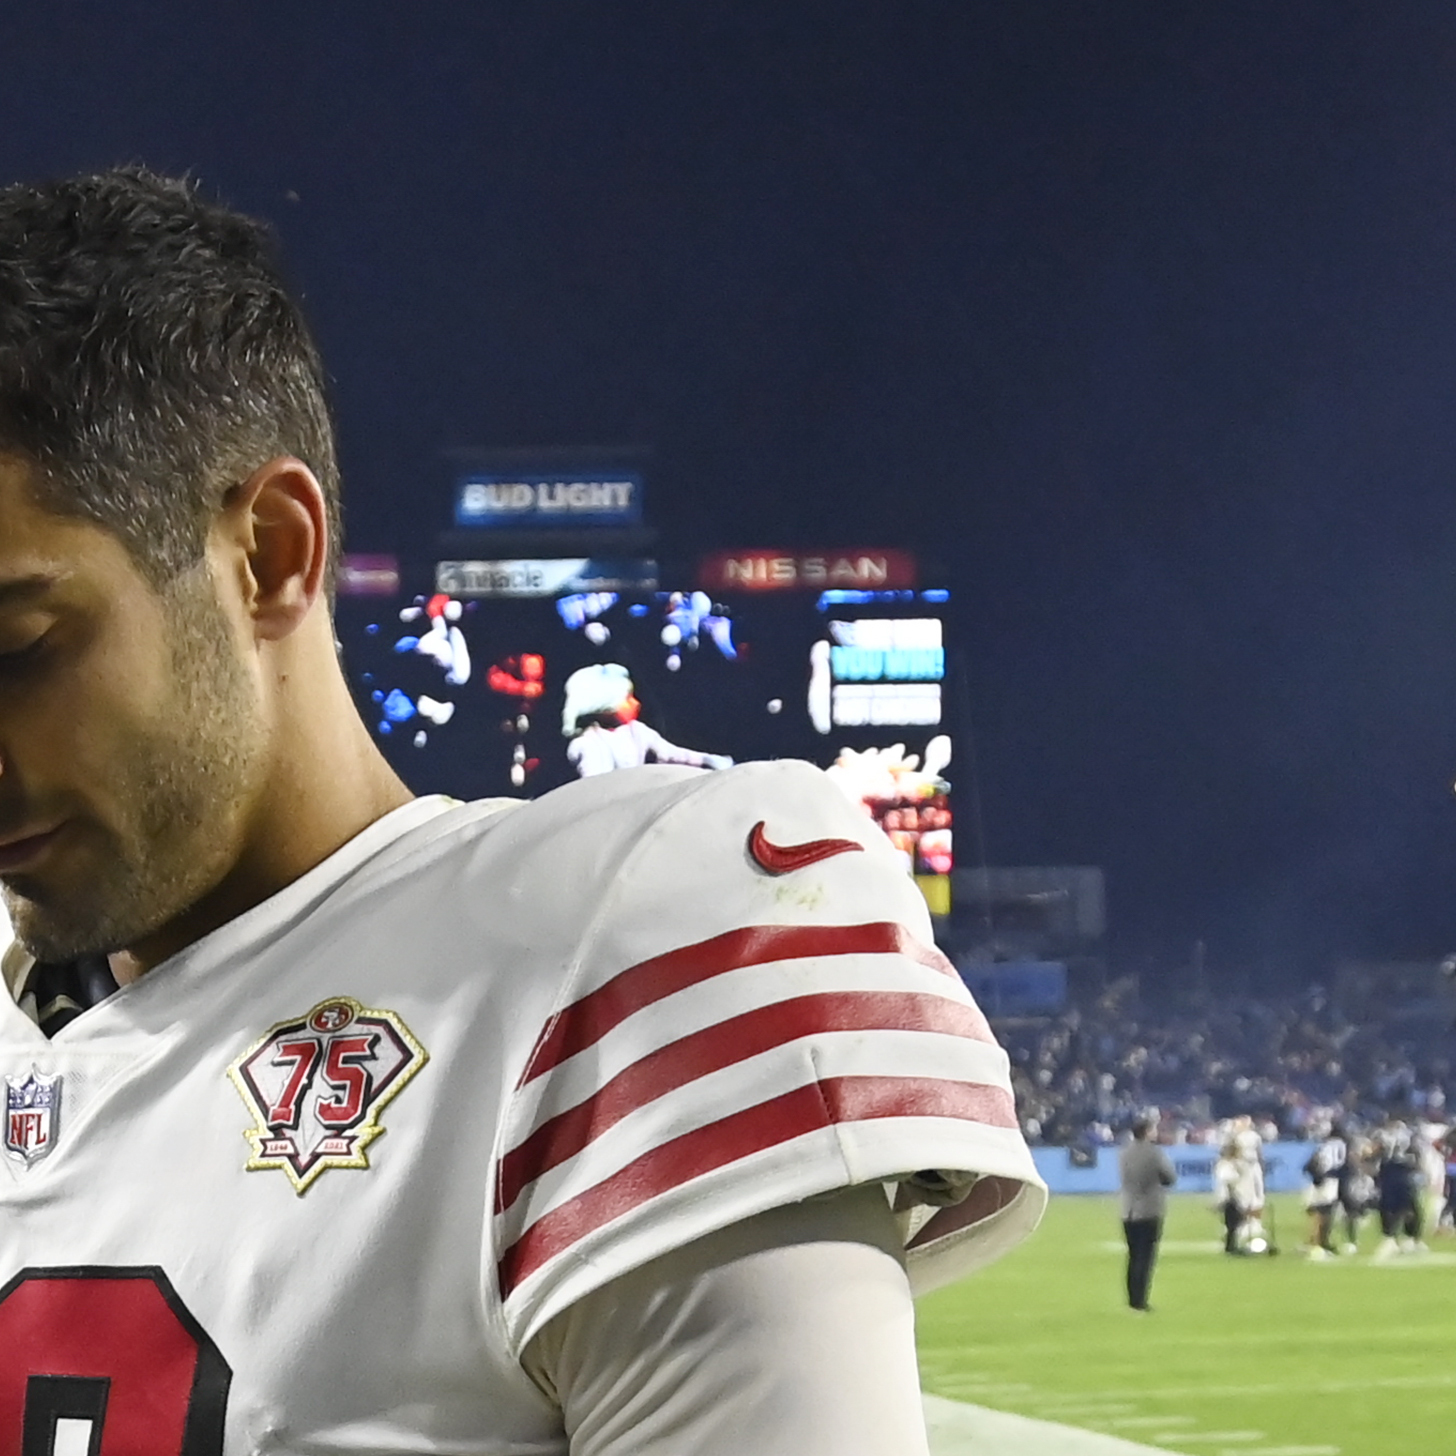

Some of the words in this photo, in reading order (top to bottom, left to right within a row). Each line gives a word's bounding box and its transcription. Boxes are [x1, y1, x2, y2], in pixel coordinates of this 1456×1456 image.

[461, 483, 534, 513] BUD
[538, 481, 634, 511] LIGHT
[724, 556, 889, 583] NISSAN
[831, 646, 883, 680] YOU
[267, 1033, 377, 1131] 75
[9, 1112, 47, 1150] NFL
